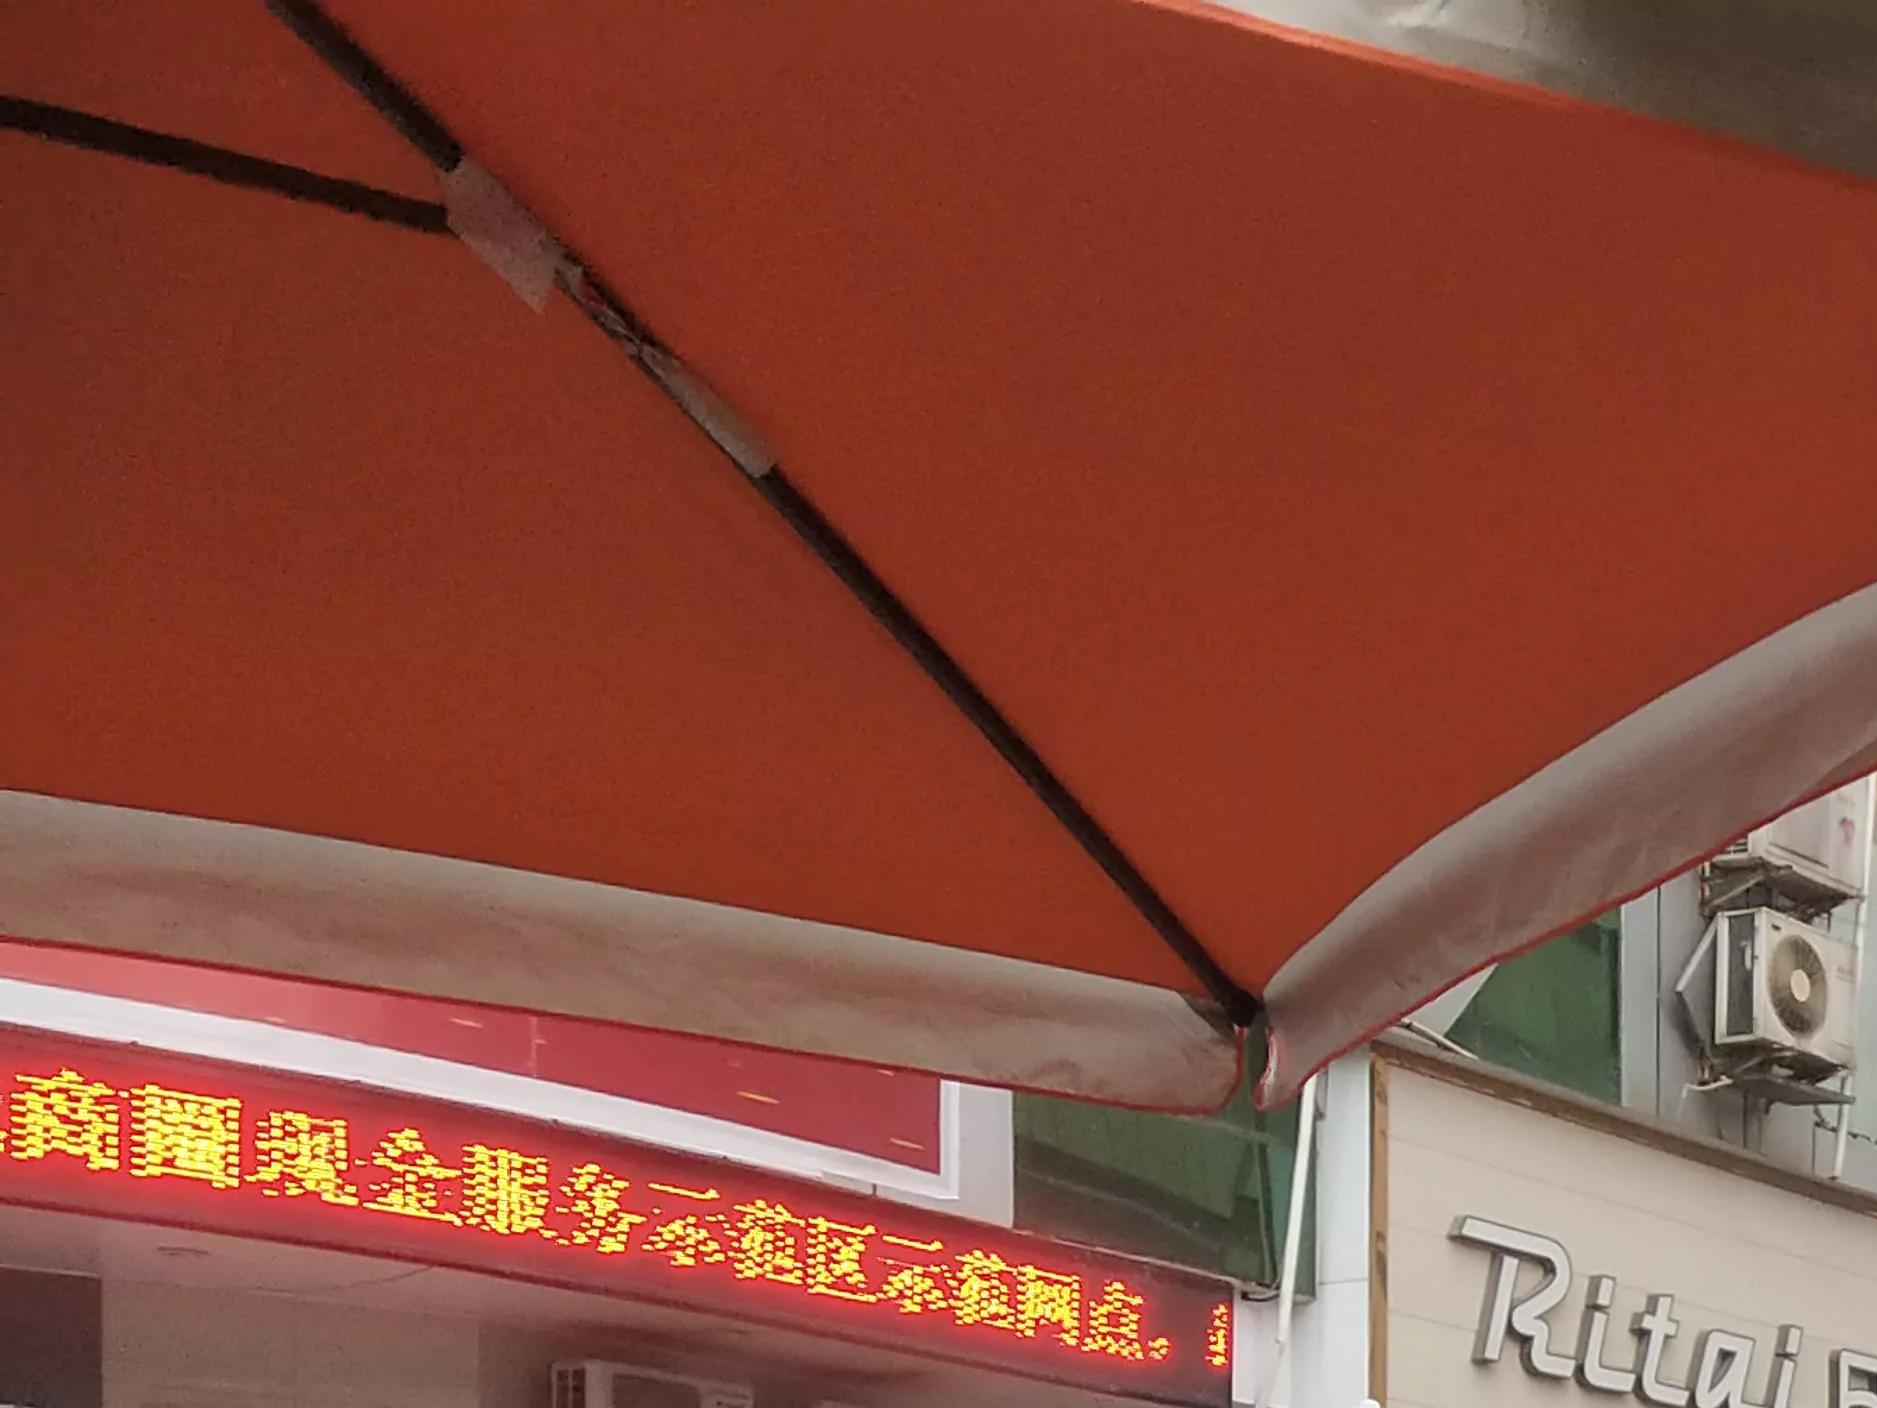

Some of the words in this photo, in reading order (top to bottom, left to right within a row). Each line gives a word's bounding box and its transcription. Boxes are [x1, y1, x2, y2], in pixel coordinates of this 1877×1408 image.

[0, 1066, 1171, 1361] 商圈现金服务示范区示范网点。
